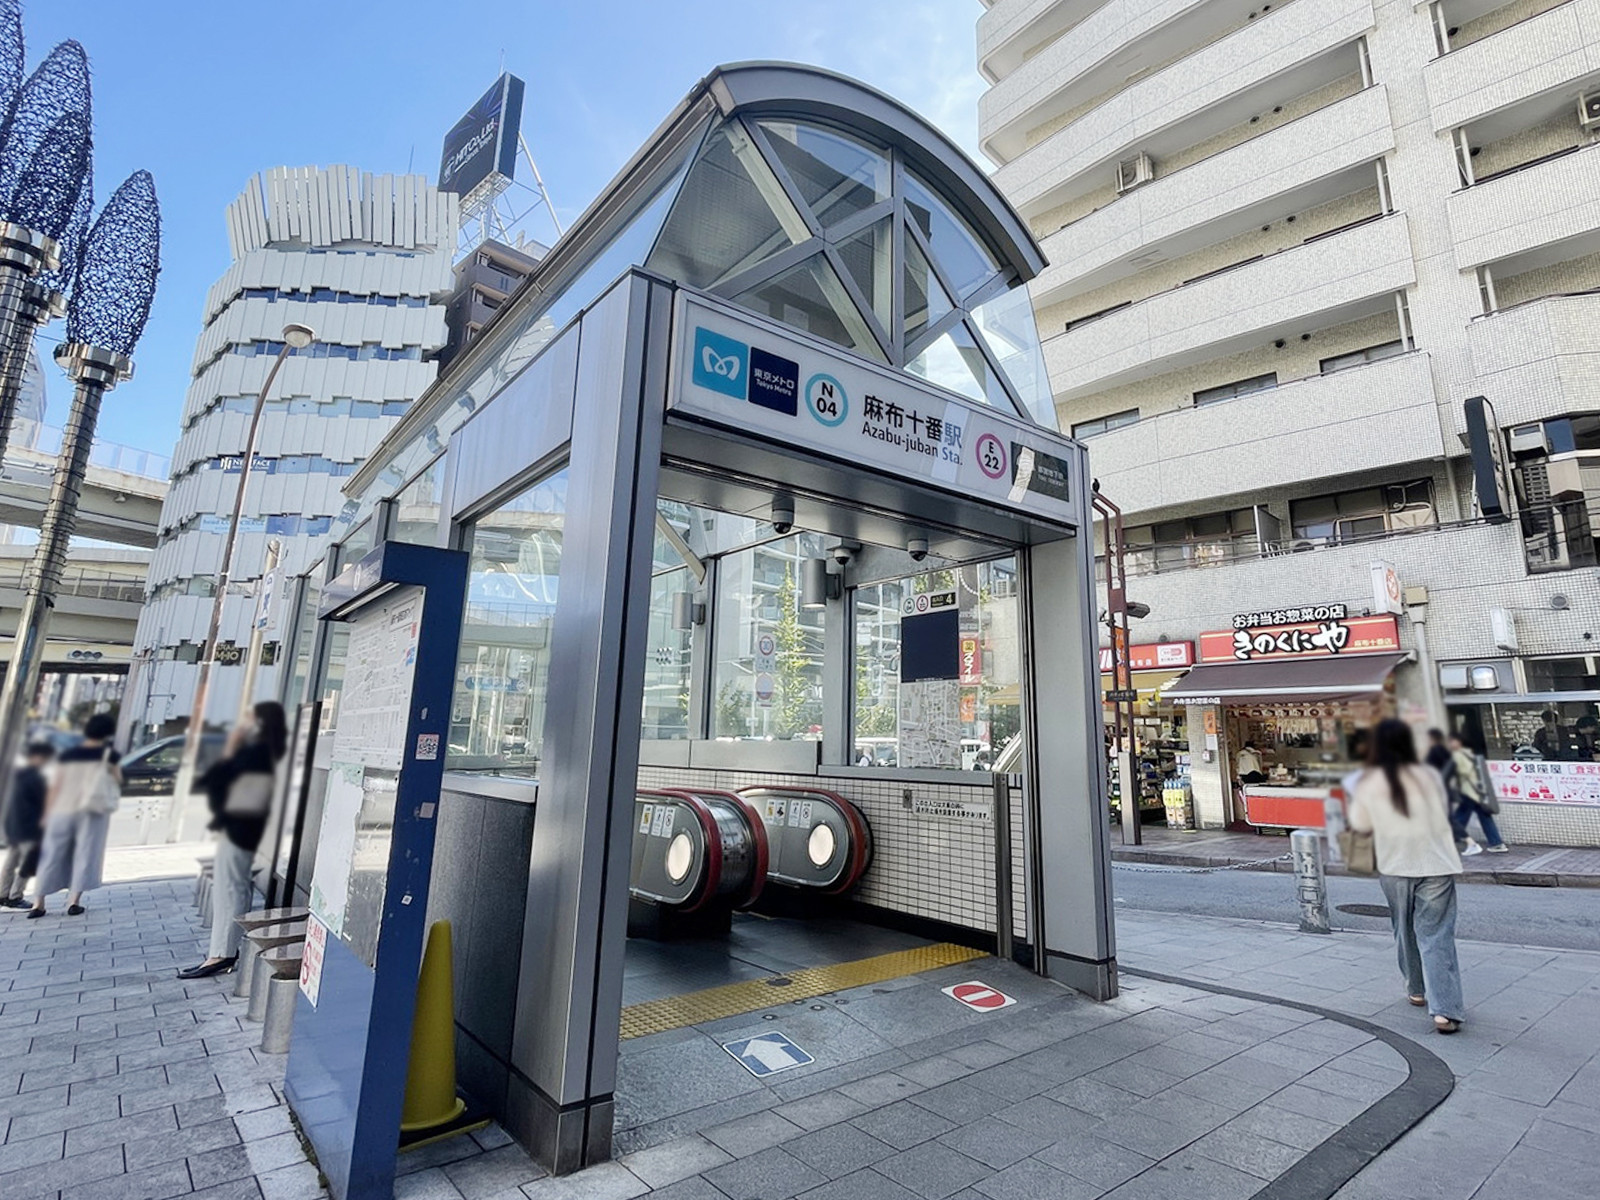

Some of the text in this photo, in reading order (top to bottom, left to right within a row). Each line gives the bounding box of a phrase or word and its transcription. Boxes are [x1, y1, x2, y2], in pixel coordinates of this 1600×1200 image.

[753, 368, 795, 389] 東京メトロ
[756, 379, 792, 396] Tokyo Metro
[821, 382, 834, 398] N
[816, 397, 838, 417] 04
[863, 394, 963, 449] 麻布十番駅
[862, 421, 963, 466] Azabu-juban Sta.
[988, 441, 995, 454] E
[984, 453, 1000, 470] 22
[946, 593, 953, 605] 4
[1233, 604, 1346, 629] お弁当お惣菜の店
[1232, 621, 1349, 660] きのくにや
